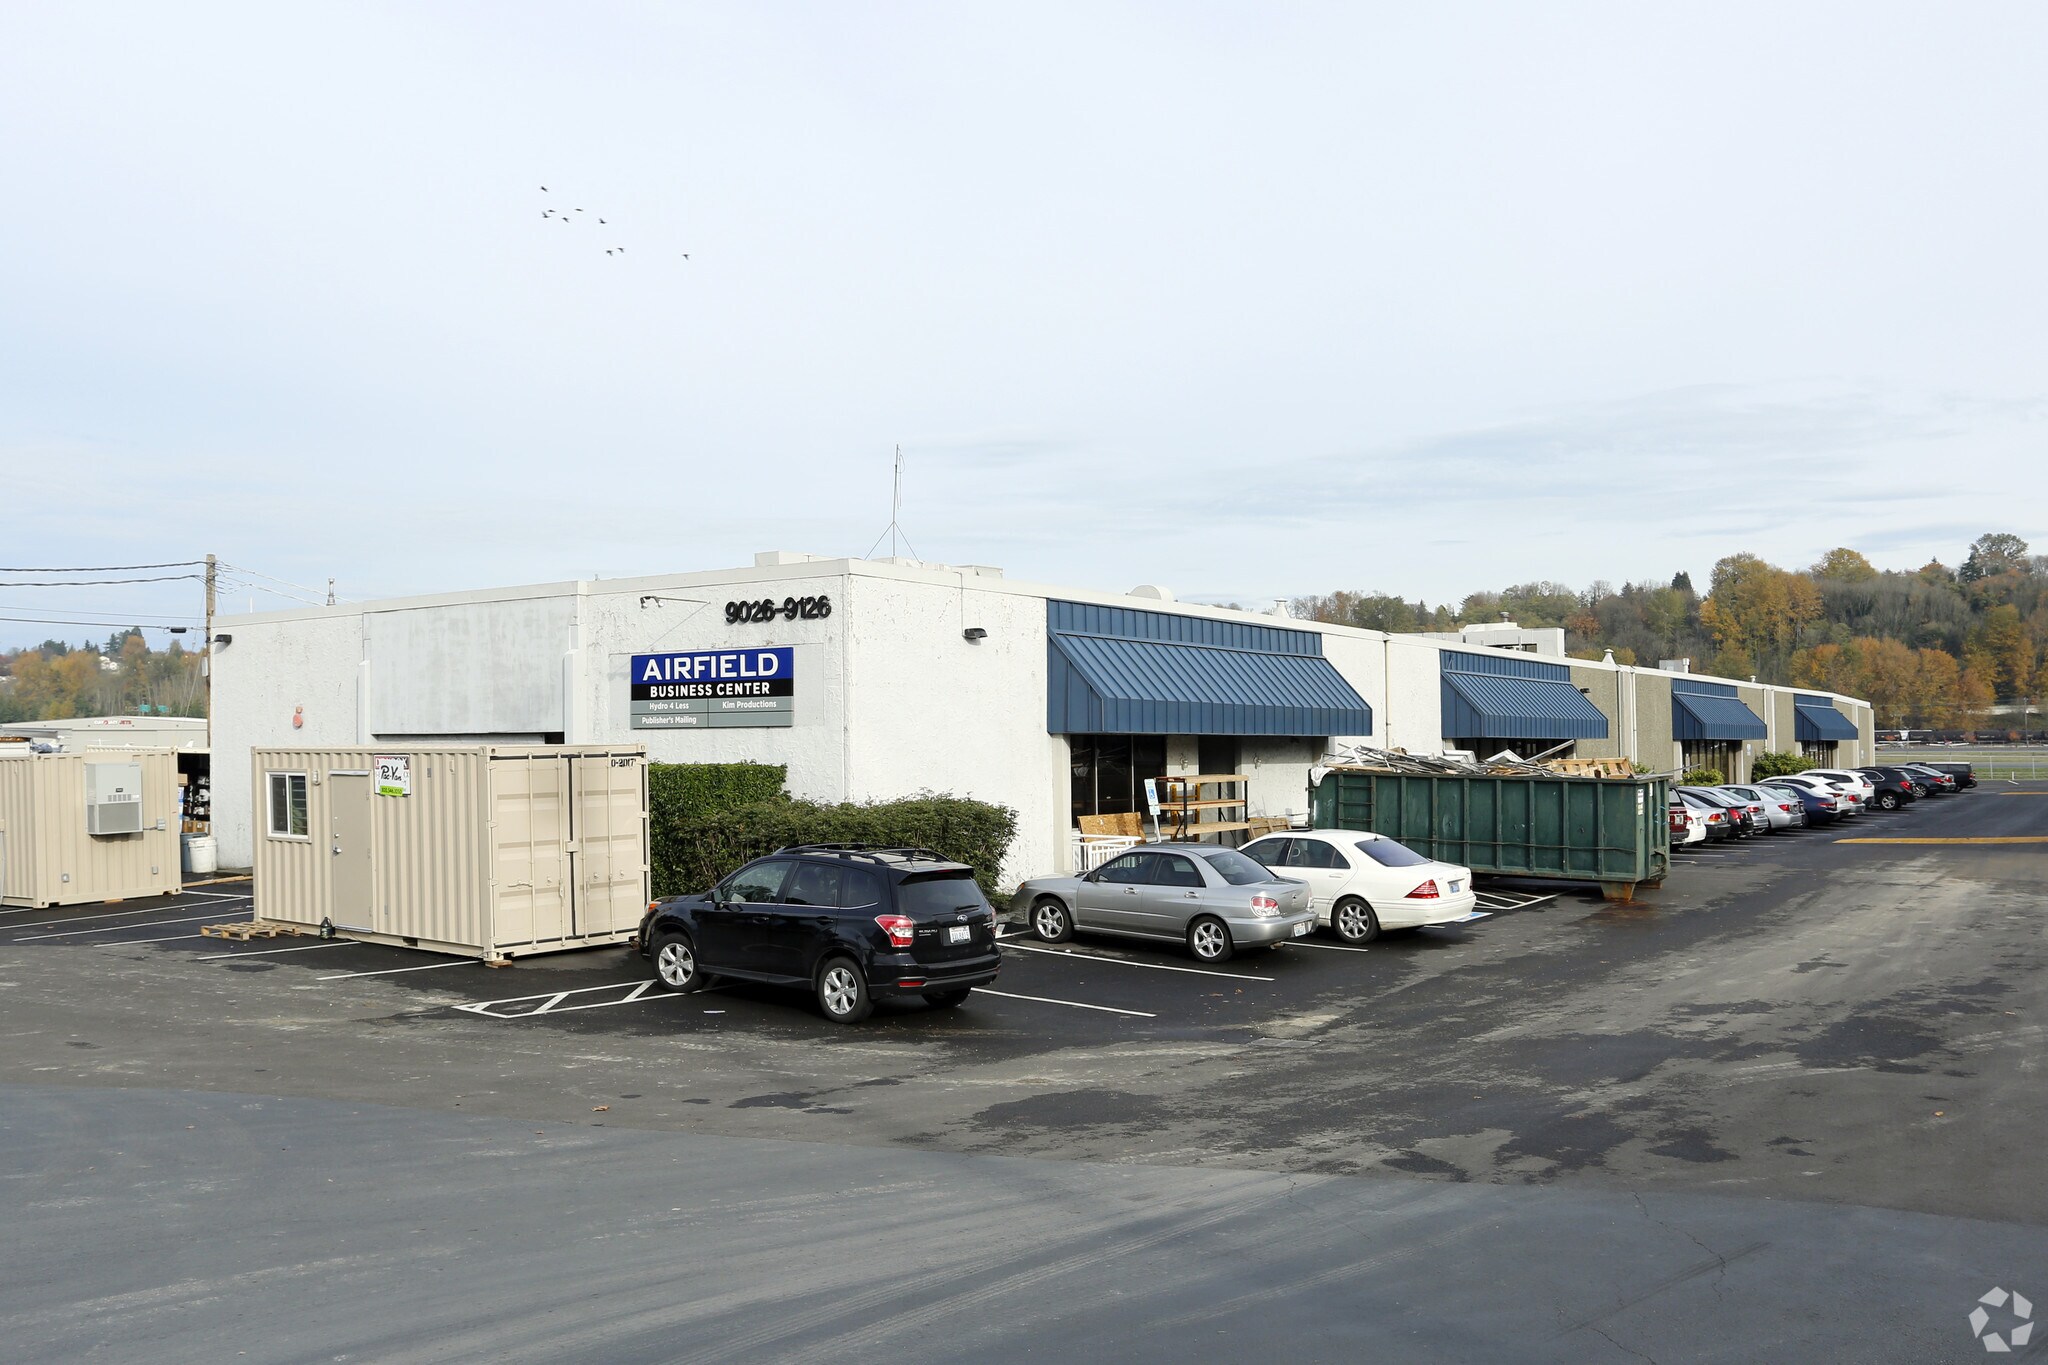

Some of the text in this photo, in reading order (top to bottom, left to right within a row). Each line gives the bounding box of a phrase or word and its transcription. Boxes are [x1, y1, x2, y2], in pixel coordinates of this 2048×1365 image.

[725, 595, 832, 624] 9026-9126
[642, 653, 779, 681] AIRFIELD
[650, 682, 770, 698] BUSINESS CENTER
[649, 702, 668, 711] Hydro
[722, 700, 777, 709] Kim Productions
[641, 716, 697, 724] Publisher's Mailing
